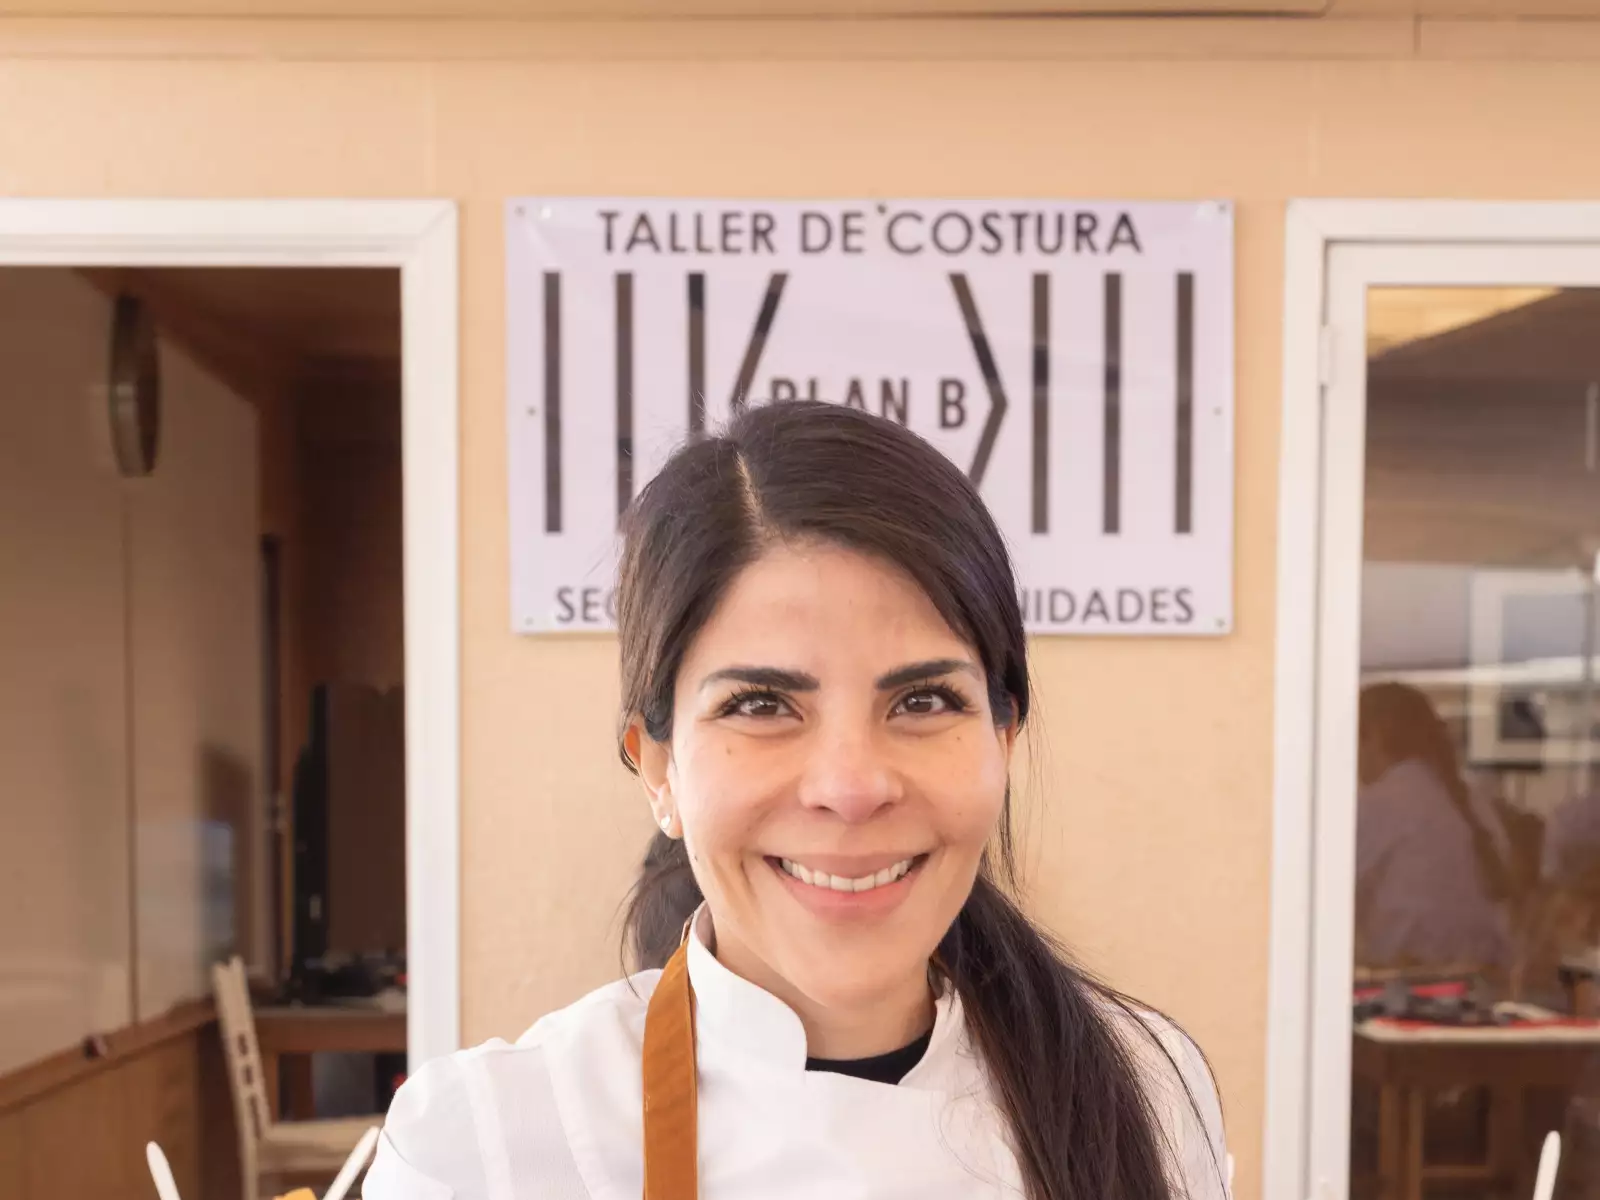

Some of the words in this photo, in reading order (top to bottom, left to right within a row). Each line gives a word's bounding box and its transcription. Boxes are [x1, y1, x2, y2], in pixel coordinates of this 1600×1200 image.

[597, 210, 778, 254] TALLER
[800, 210, 865, 254] DE
[885, 209, 1144, 256] COSTURA
[938, 377, 966, 429] B
